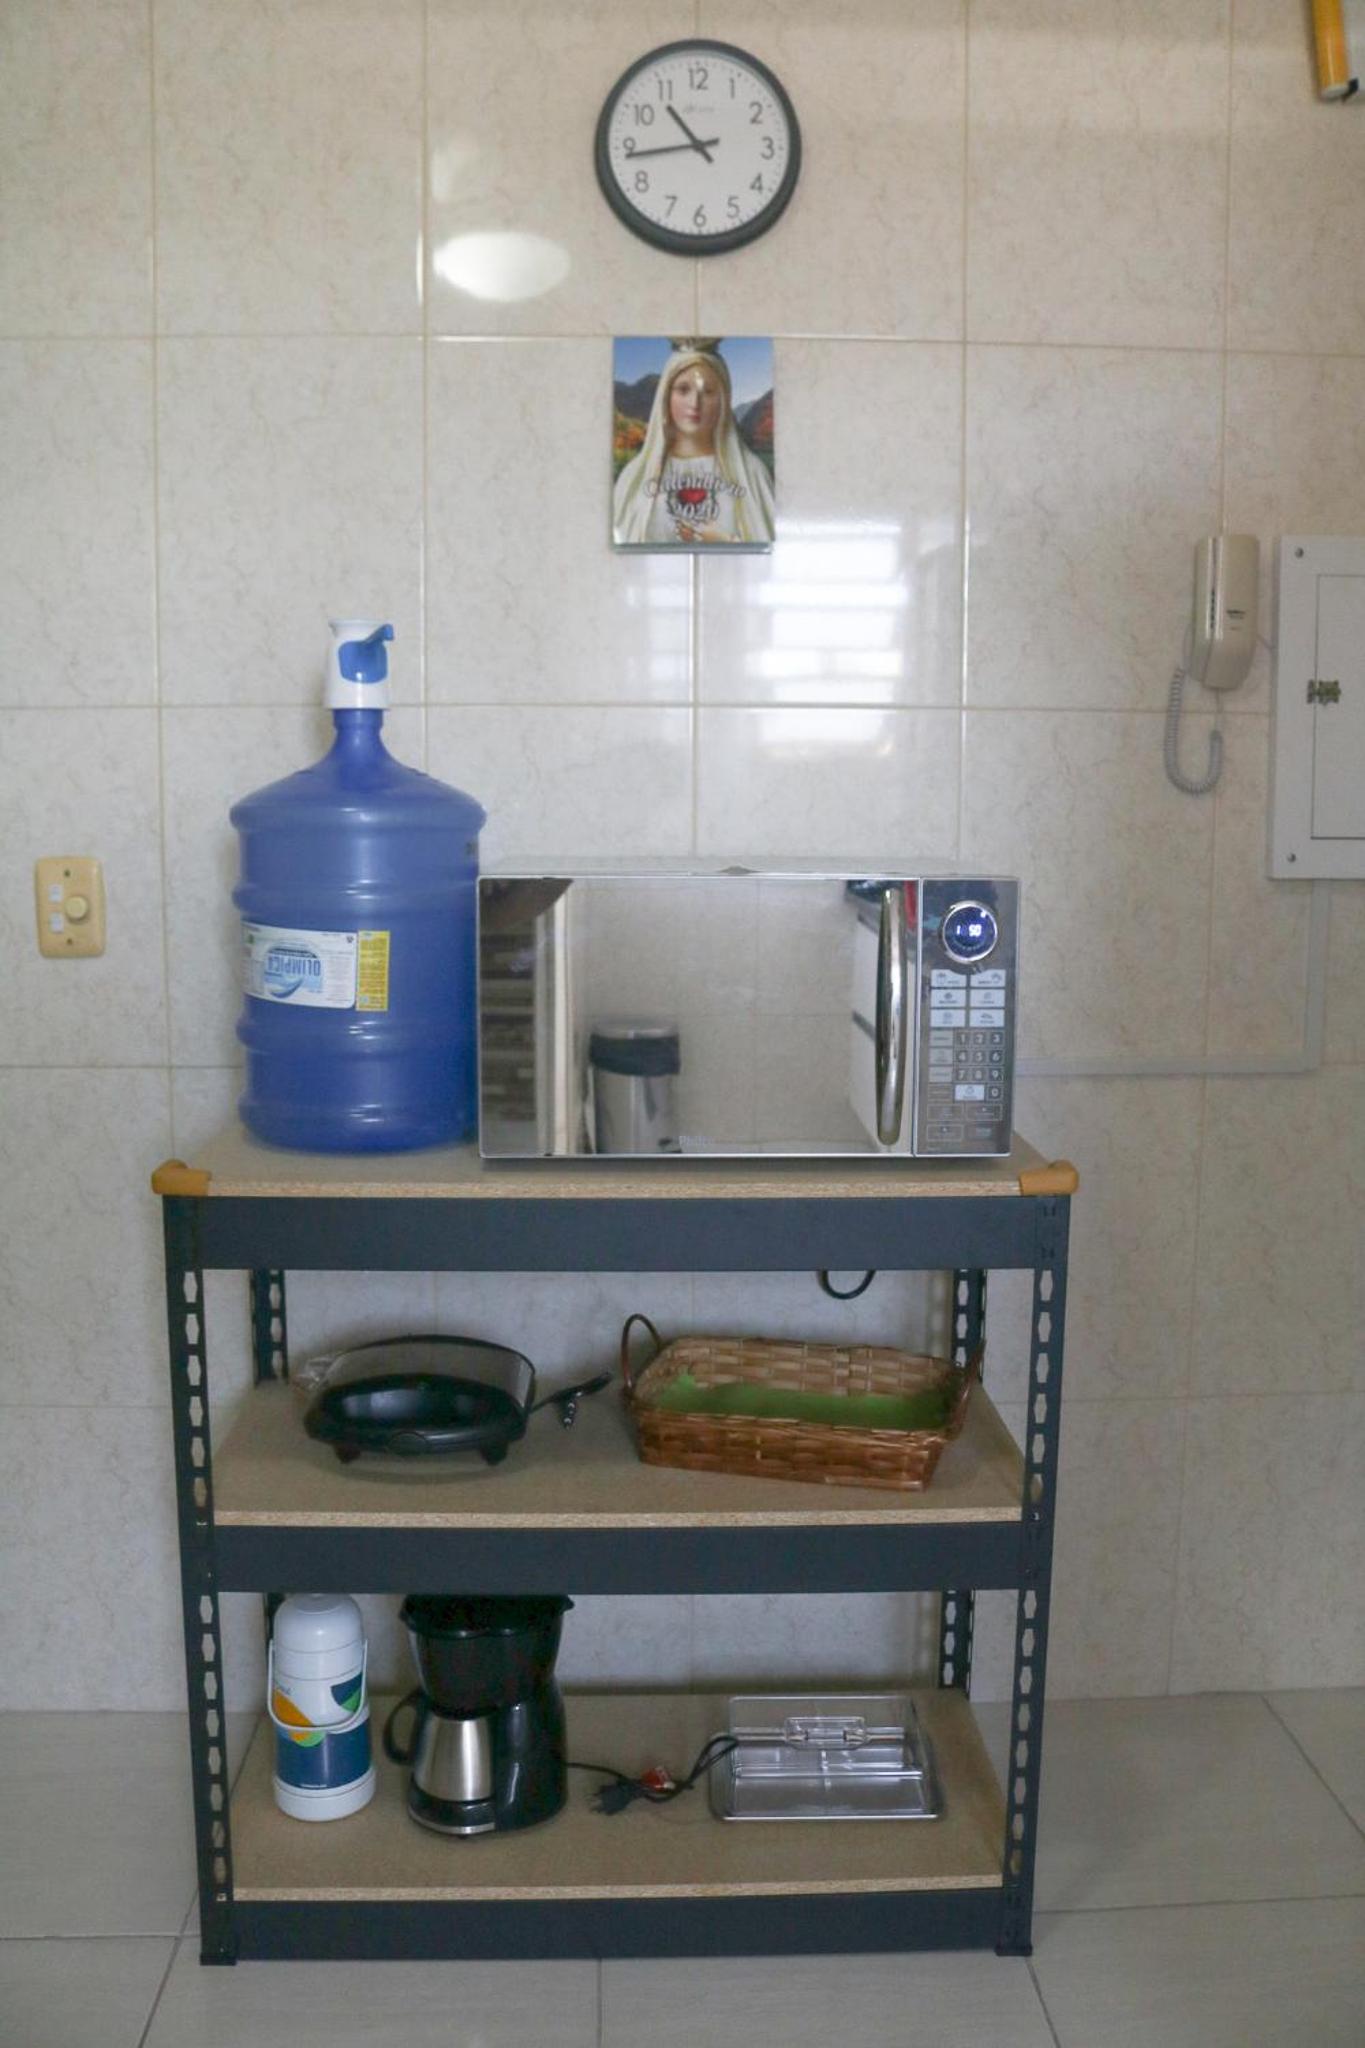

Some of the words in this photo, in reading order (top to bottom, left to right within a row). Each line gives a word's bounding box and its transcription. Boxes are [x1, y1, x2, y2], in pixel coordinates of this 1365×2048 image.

[658, 79, 673, 101] 11
[688, 67, 709, 90] 12
[729, 77, 736, 99] 1
[634, 103, 655, 126] 10
[750, 101, 763, 125] 2
[622, 136, 636, 158] 9
[761, 136, 775, 160] 3
[634, 170, 650, 194] 8
[750, 173, 764, 194] 4
[665, 195, 678, 218] 7
[693, 204, 707, 228] 6
[727, 196, 740, 219] 5
